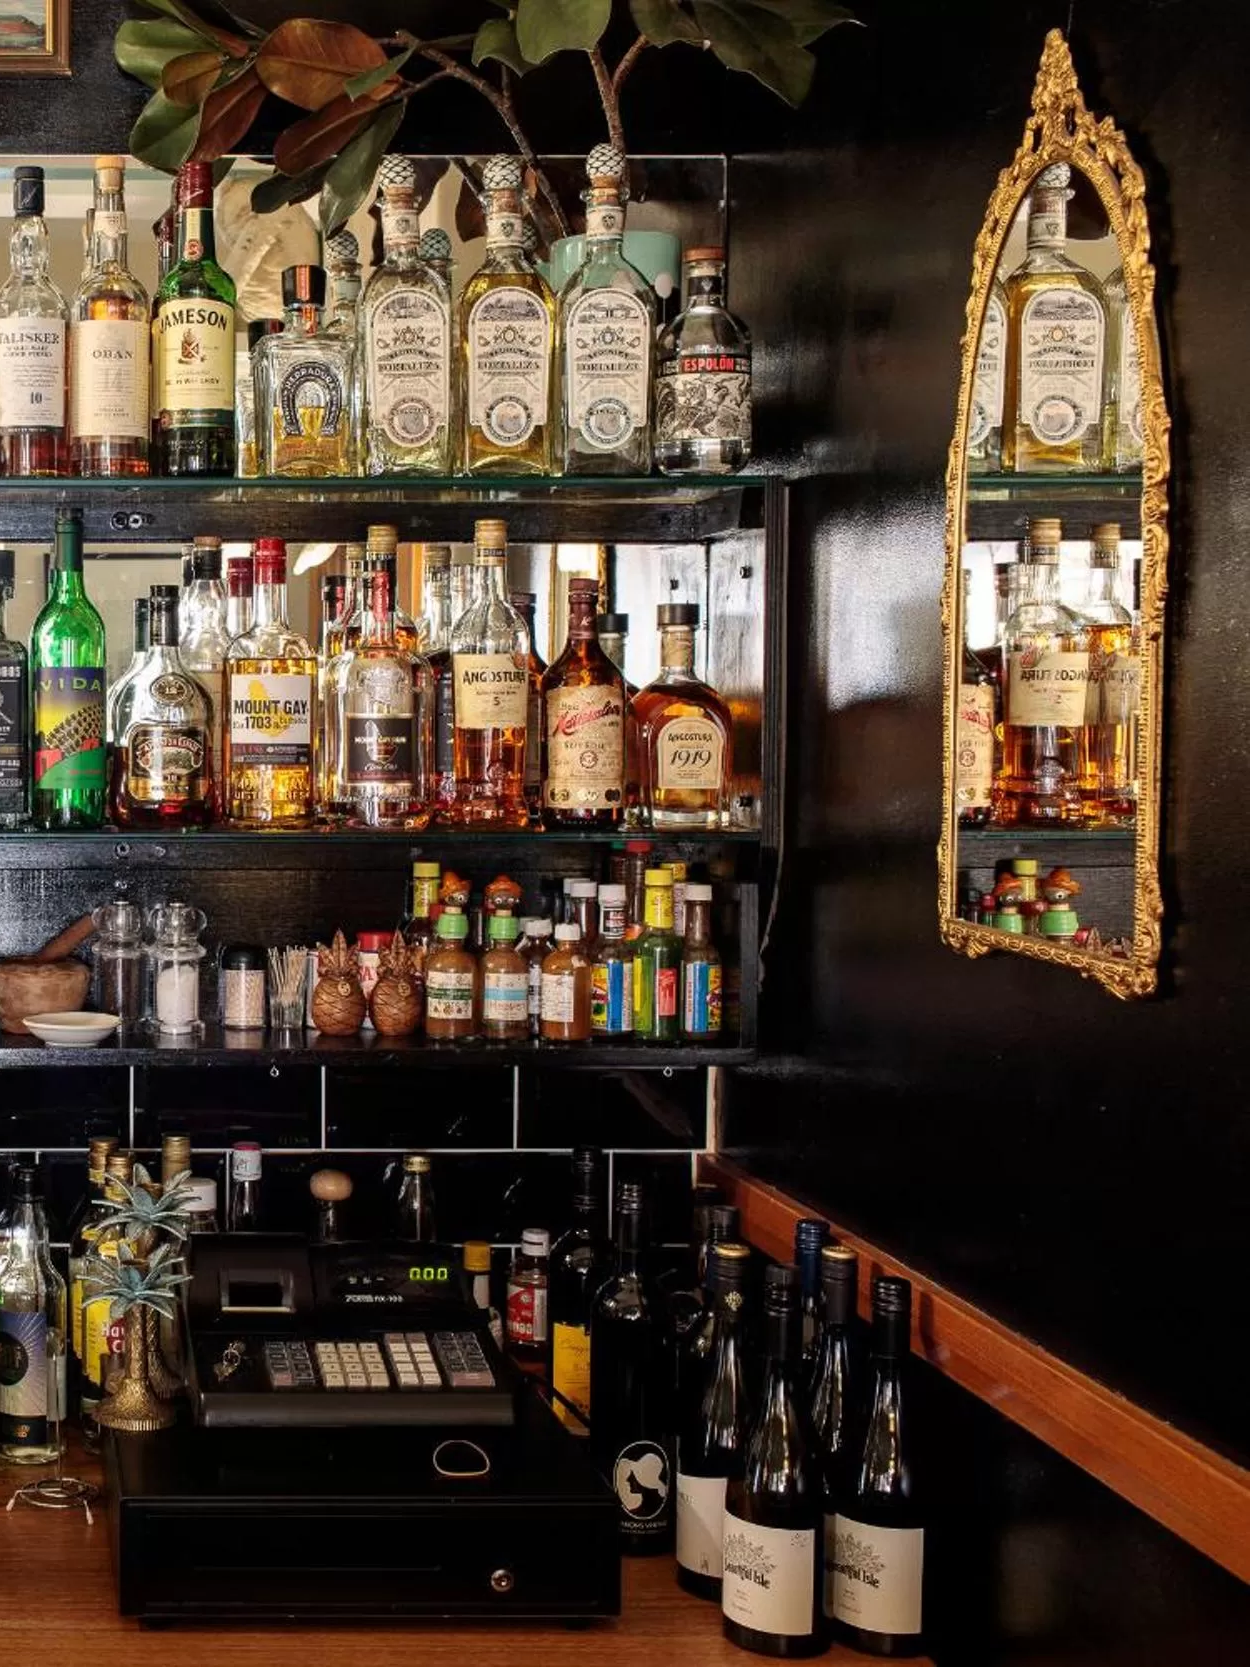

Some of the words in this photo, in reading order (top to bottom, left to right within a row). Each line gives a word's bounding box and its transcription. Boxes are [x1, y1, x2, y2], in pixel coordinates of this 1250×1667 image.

[159, 307, 229, 334] JAMESON
[92, 349, 134, 360] OBAN
[29, 391, 44, 405] 10
[40, 677, 101, 692] VIDA
[462, 669, 526, 685] ANGOSTURA
[234, 699, 280, 715] MOUNT
[284, 699, 308, 715] GAY
[245, 716, 271, 729] 1703
[670, 749, 712, 769] 1919
